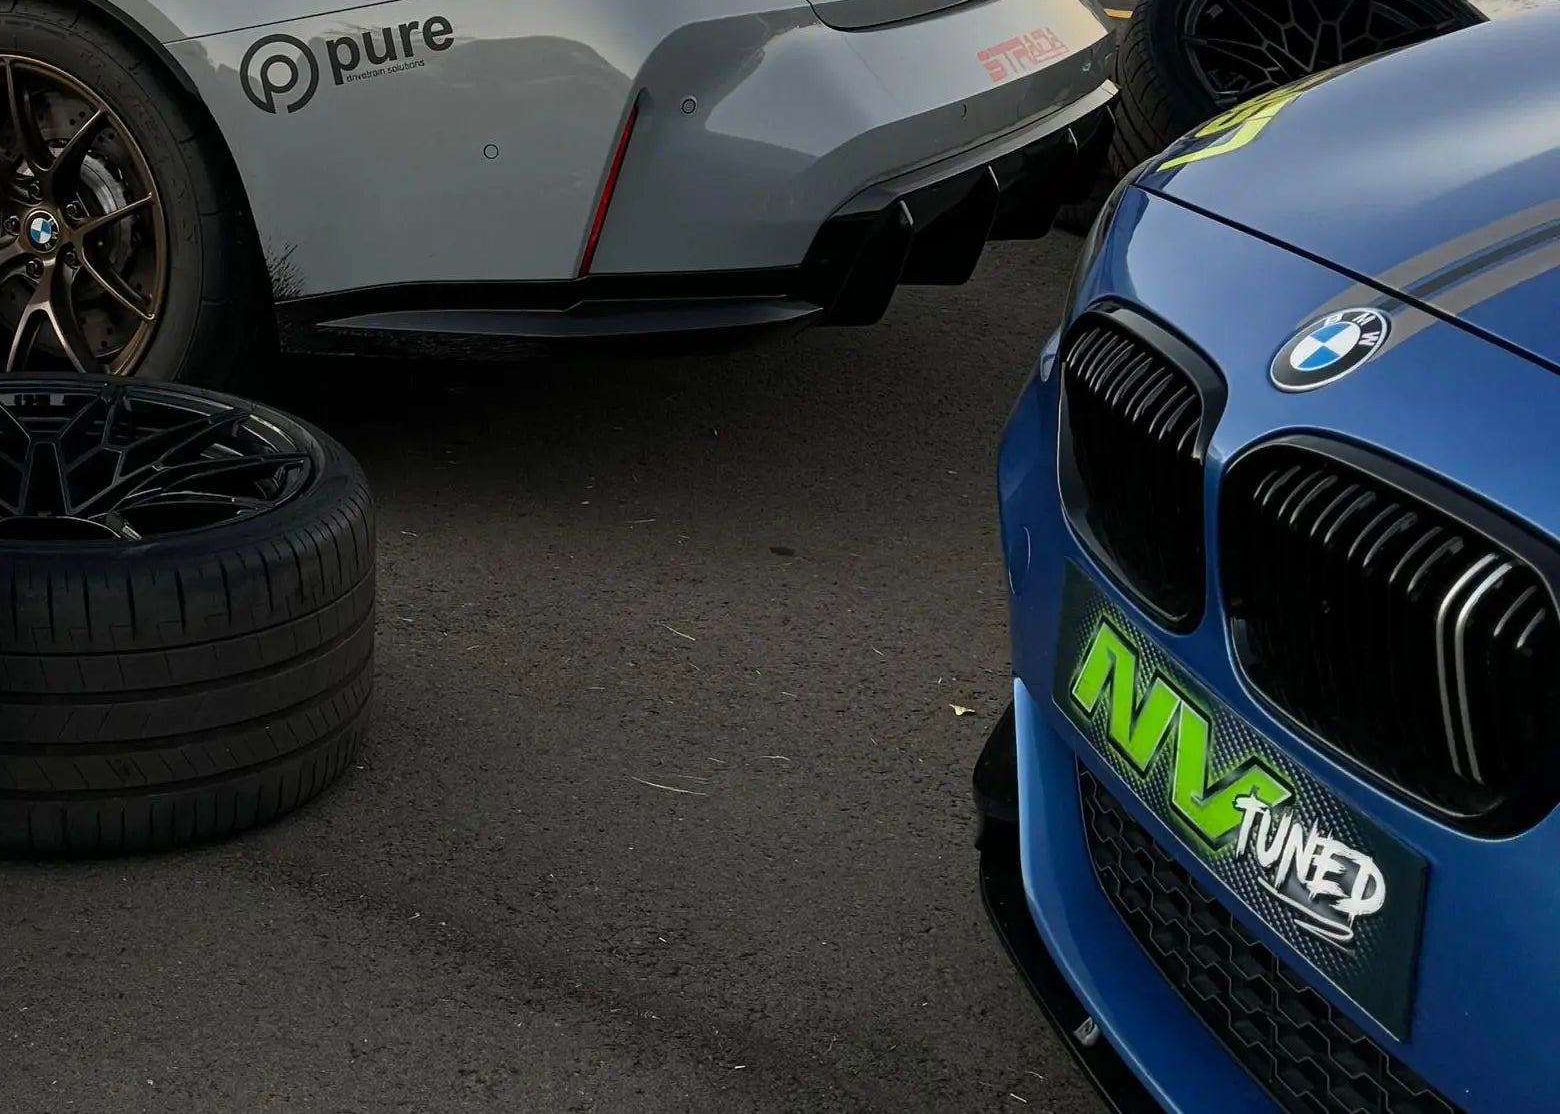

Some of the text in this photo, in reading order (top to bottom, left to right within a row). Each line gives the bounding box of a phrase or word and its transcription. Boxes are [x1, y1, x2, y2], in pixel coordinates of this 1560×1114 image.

[326, 16, 455, 86] pure
[387, 60, 426, 74] solutions
[977, 26, 1069, 82] STRADA
[1234, 786, 1388, 924] TUNED
